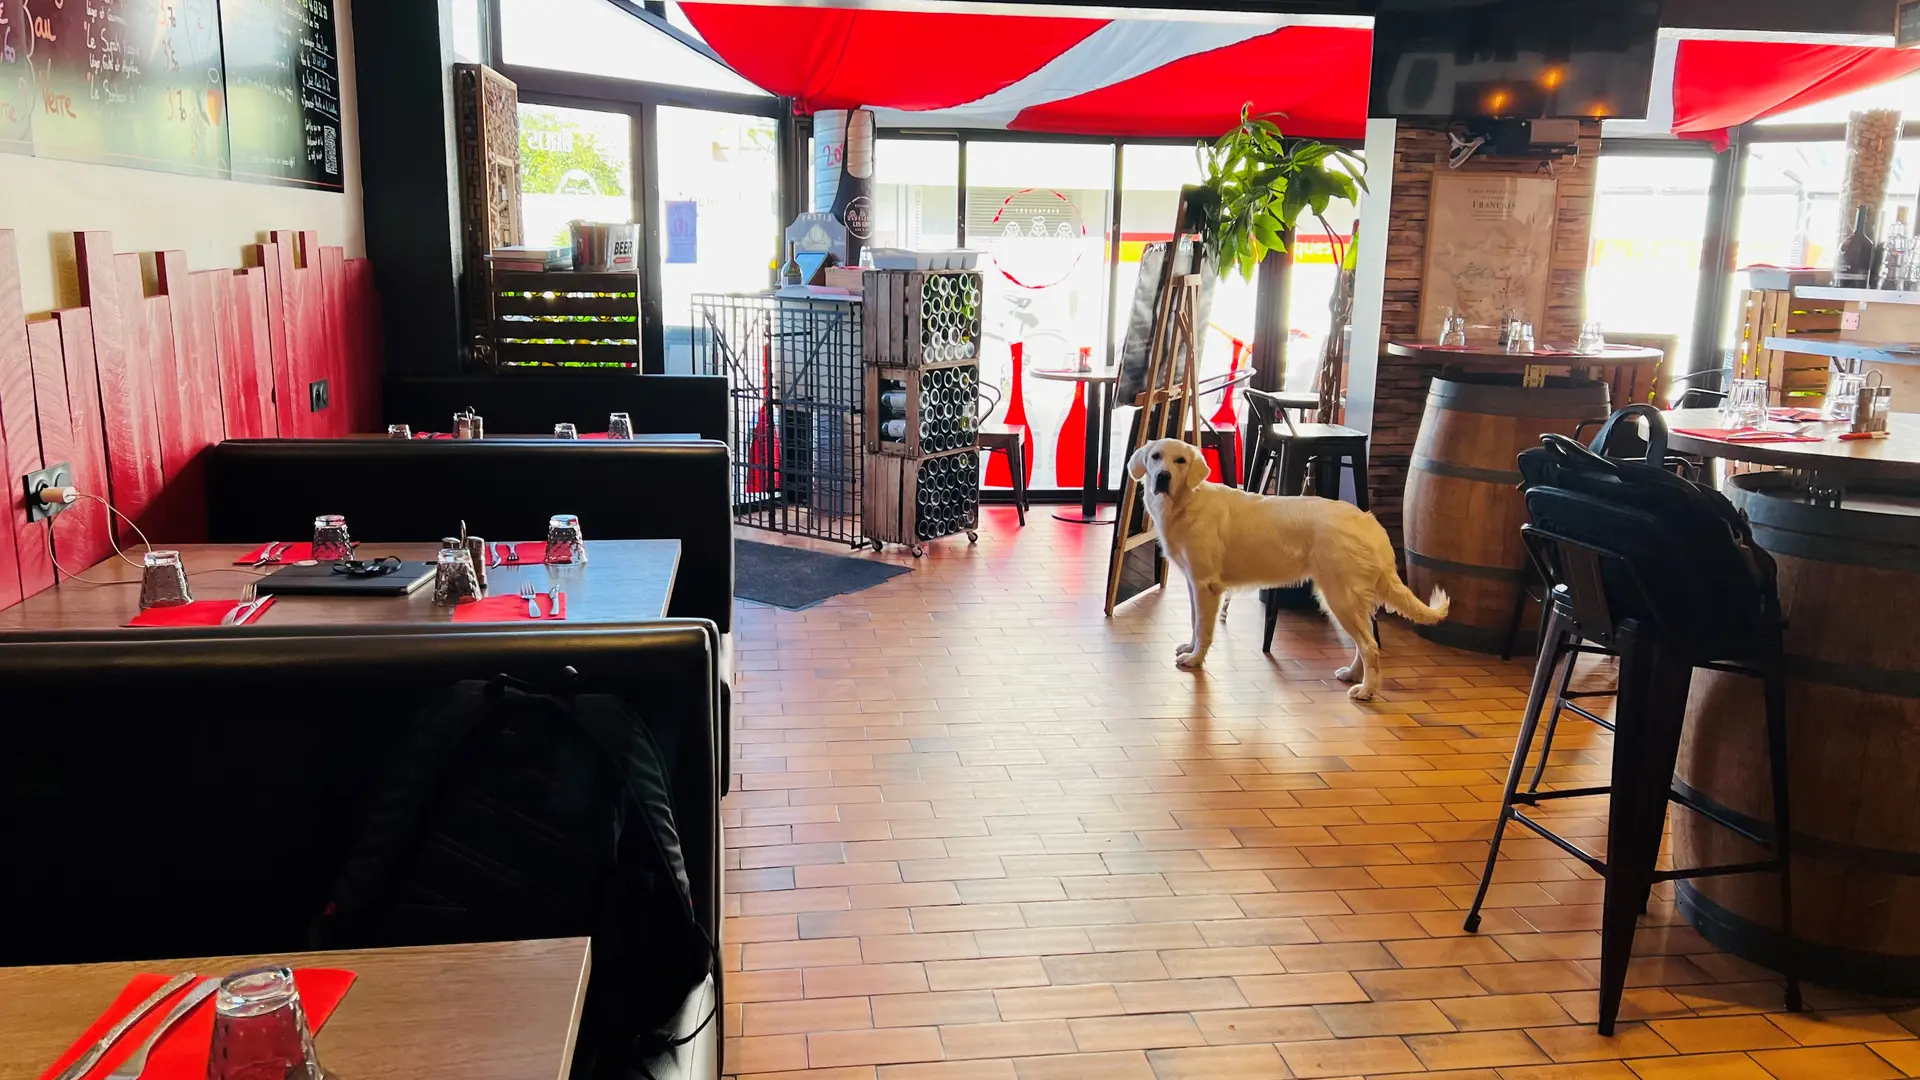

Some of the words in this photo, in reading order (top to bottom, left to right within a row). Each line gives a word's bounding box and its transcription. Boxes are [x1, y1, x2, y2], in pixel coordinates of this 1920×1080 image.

[34, 16, 57, 42] au
[38, 58, 77, 119] Verre
[613, 240, 633, 256] BEER
